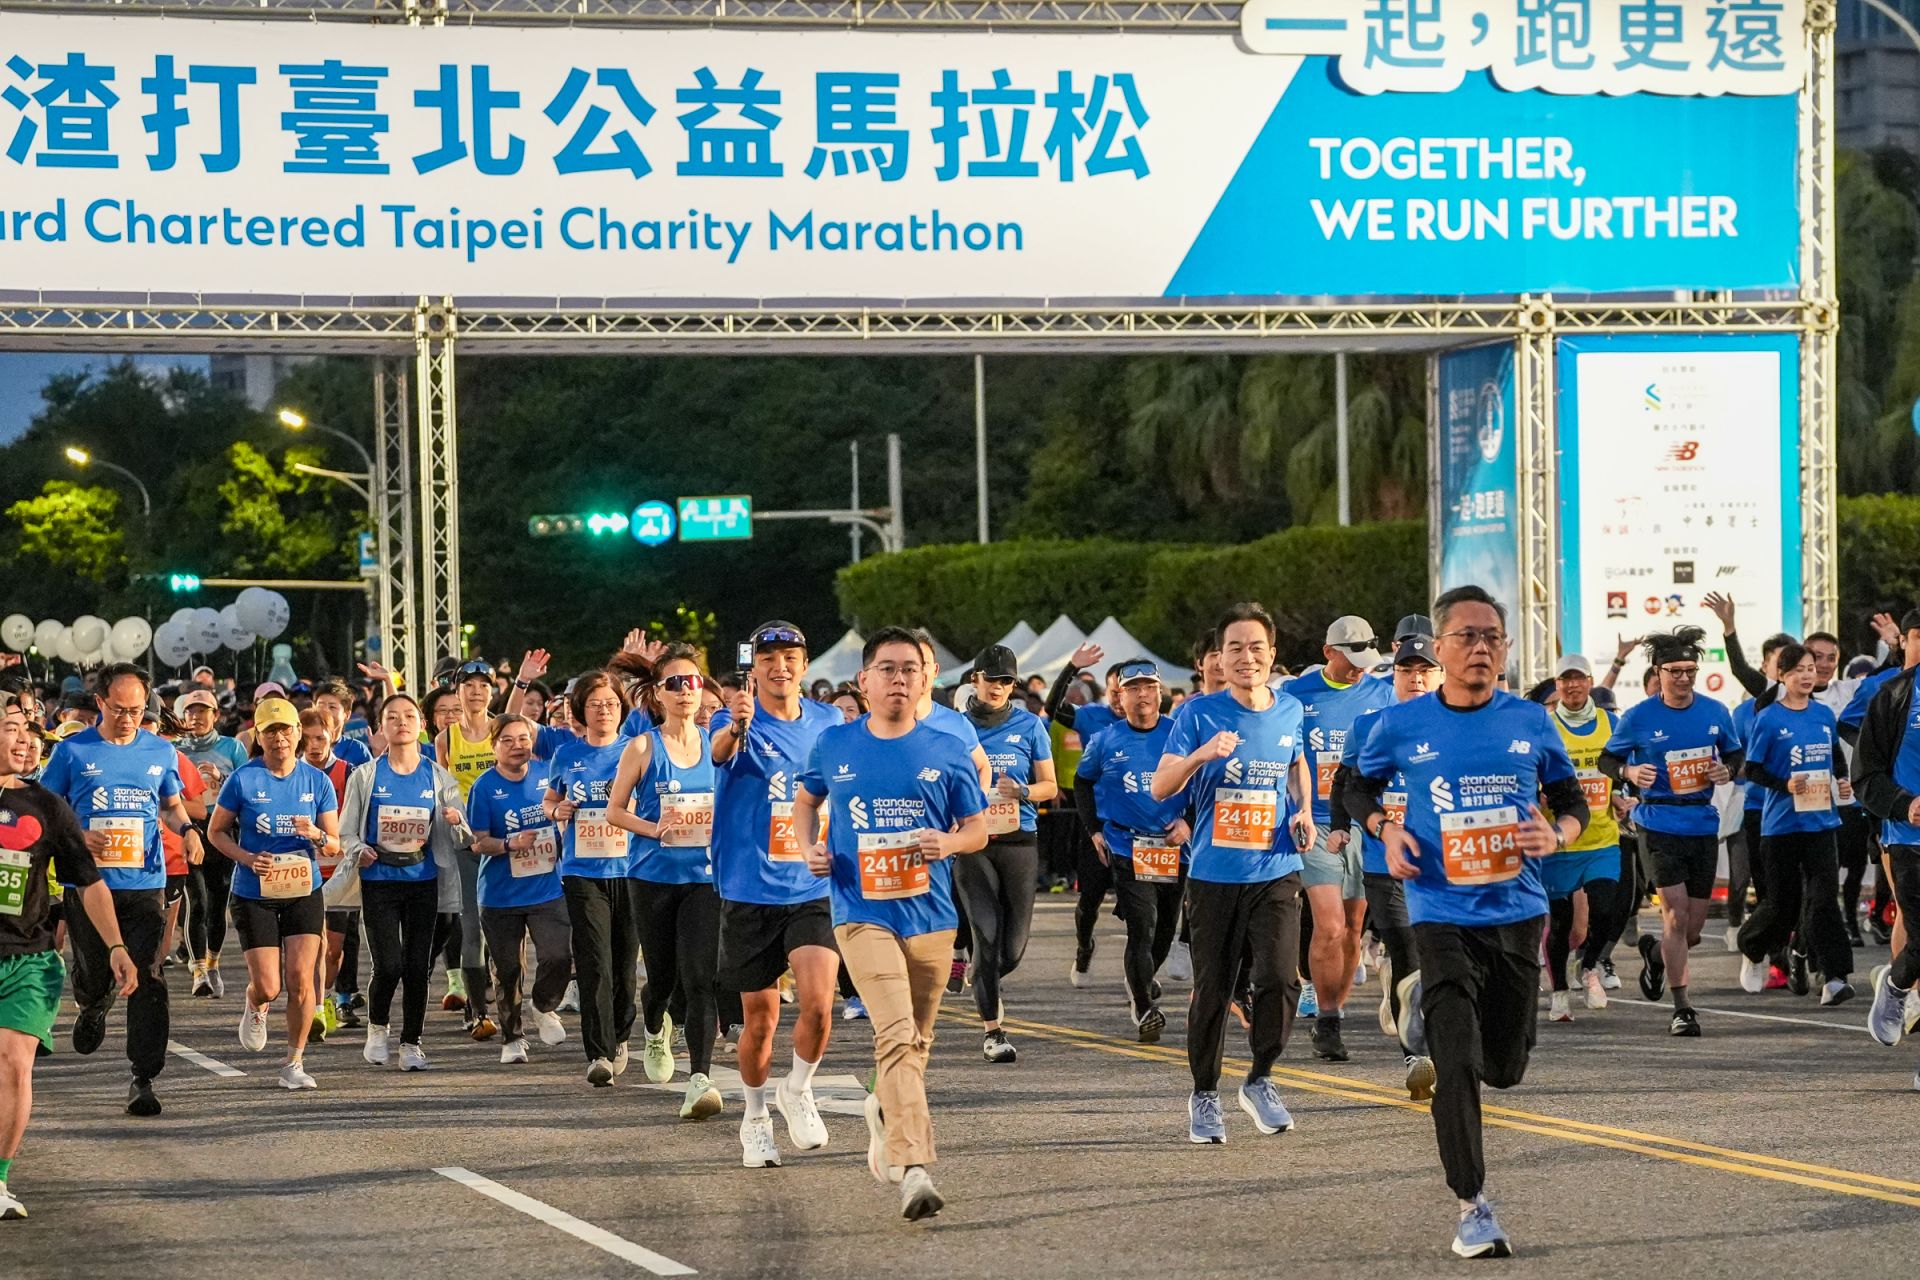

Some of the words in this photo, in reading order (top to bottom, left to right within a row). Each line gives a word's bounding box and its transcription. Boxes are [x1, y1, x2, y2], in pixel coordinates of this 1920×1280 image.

[1, 52, 1151, 182] 渣打臺北公益馬拉松
[1309, 137, 1587, 186] TOGETHER,
[1310, 199, 1394, 241] WE
[1406, 199, 1509, 241] RUN
[1522, 196, 1738, 240] FURTHER
[85, 199, 364, 248] Chartered
[381, 205, 543, 262] Taipei
[559, 207, 752, 264] Charity
[769, 209, 1024, 251] Marathon
[1459, 774, 1517, 785] standard
[1460, 783, 1519, 796] chartered
[872, 797, 924, 808] standard
[874, 807, 925, 817] chartered
[1218, 808, 1272, 826] 24182
[381, 821, 425, 835] 28076
[579, 825, 625, 838] 28104
[514, 842, 553, 859] 28110
[1448, 831, 1516, 857] 24184
[864, 852, 923, 873] 24178
[1136, 852, 1177, 866] 24162
[264, 866, 308, 882] 27708
